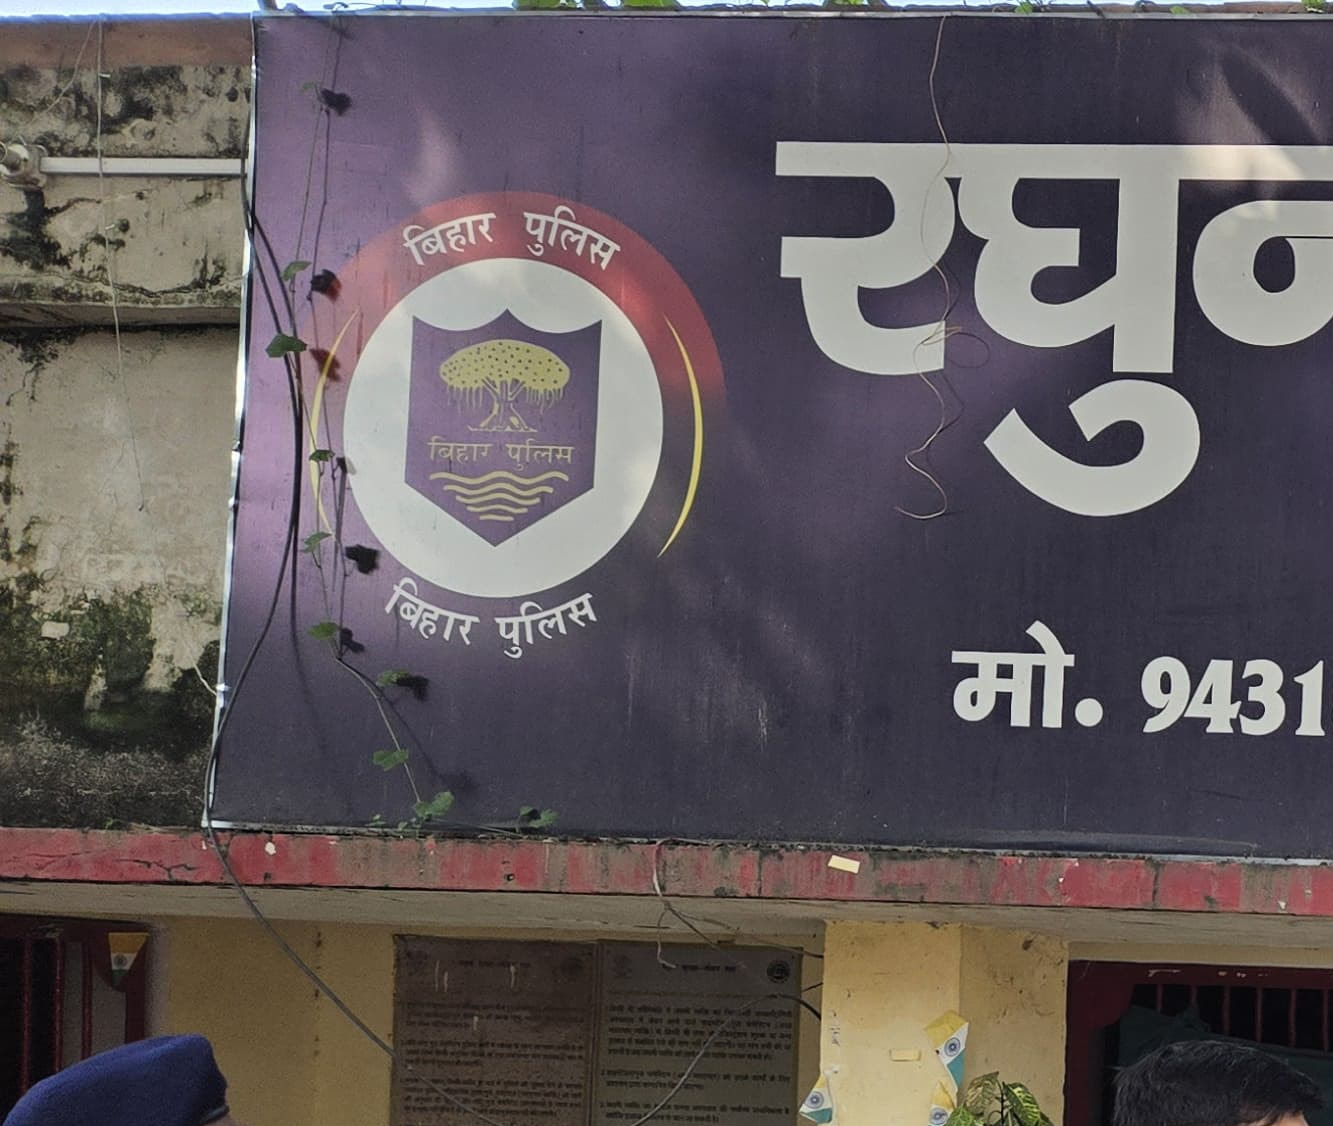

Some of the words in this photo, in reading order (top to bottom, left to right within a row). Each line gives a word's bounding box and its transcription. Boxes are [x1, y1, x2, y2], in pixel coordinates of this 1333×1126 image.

[403, 212, 496, 266] बिहार
[523, 205, 621, 271] पुलिस
[427, 435, 494, 462] बिहार
[506, 439, 575, 472] पुलिस
[385, 576, 481, 646] बिहार
[494, 592, 598, 659] पुलिस
[951, 621, 1103, 729] मो.
